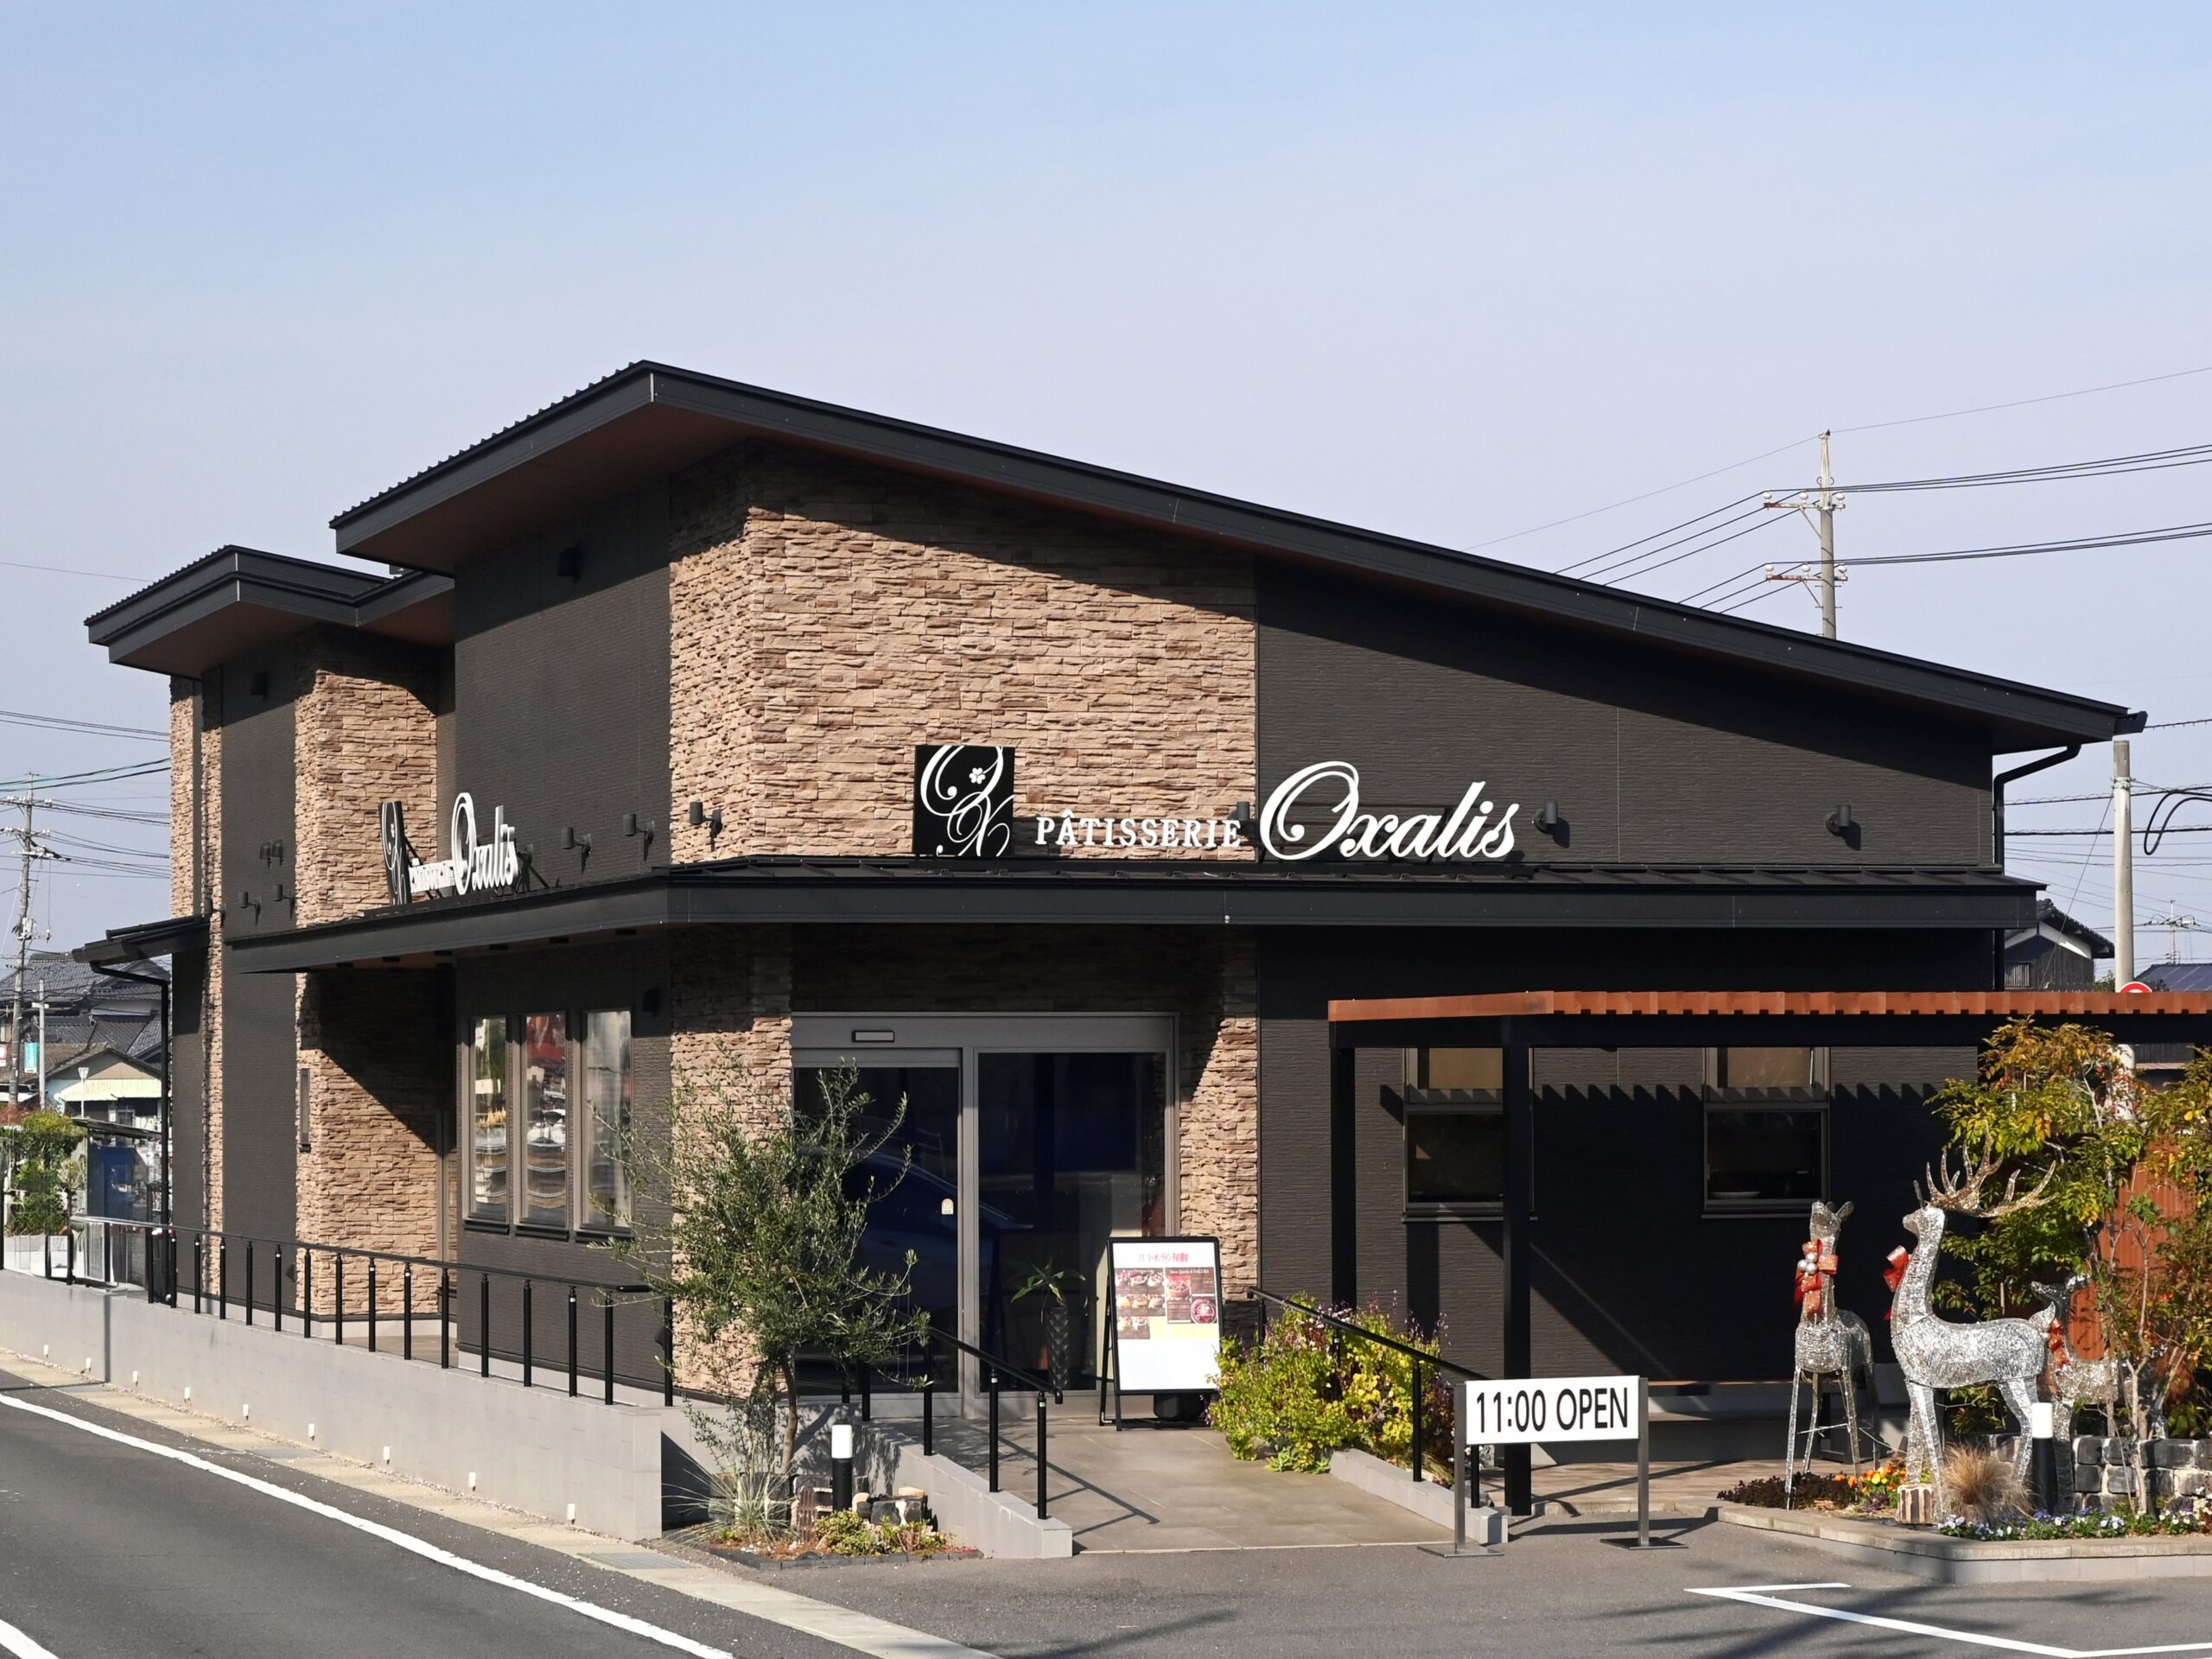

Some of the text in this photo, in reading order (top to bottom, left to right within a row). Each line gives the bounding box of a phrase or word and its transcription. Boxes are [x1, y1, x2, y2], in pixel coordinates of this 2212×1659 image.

[451, 792, 519, 895] Oxalis
[1036, 761, 1520, 861] PÂTISSERIE Oxalis
[1477, 1387, 1628, 1433] 11:00 OPEN
